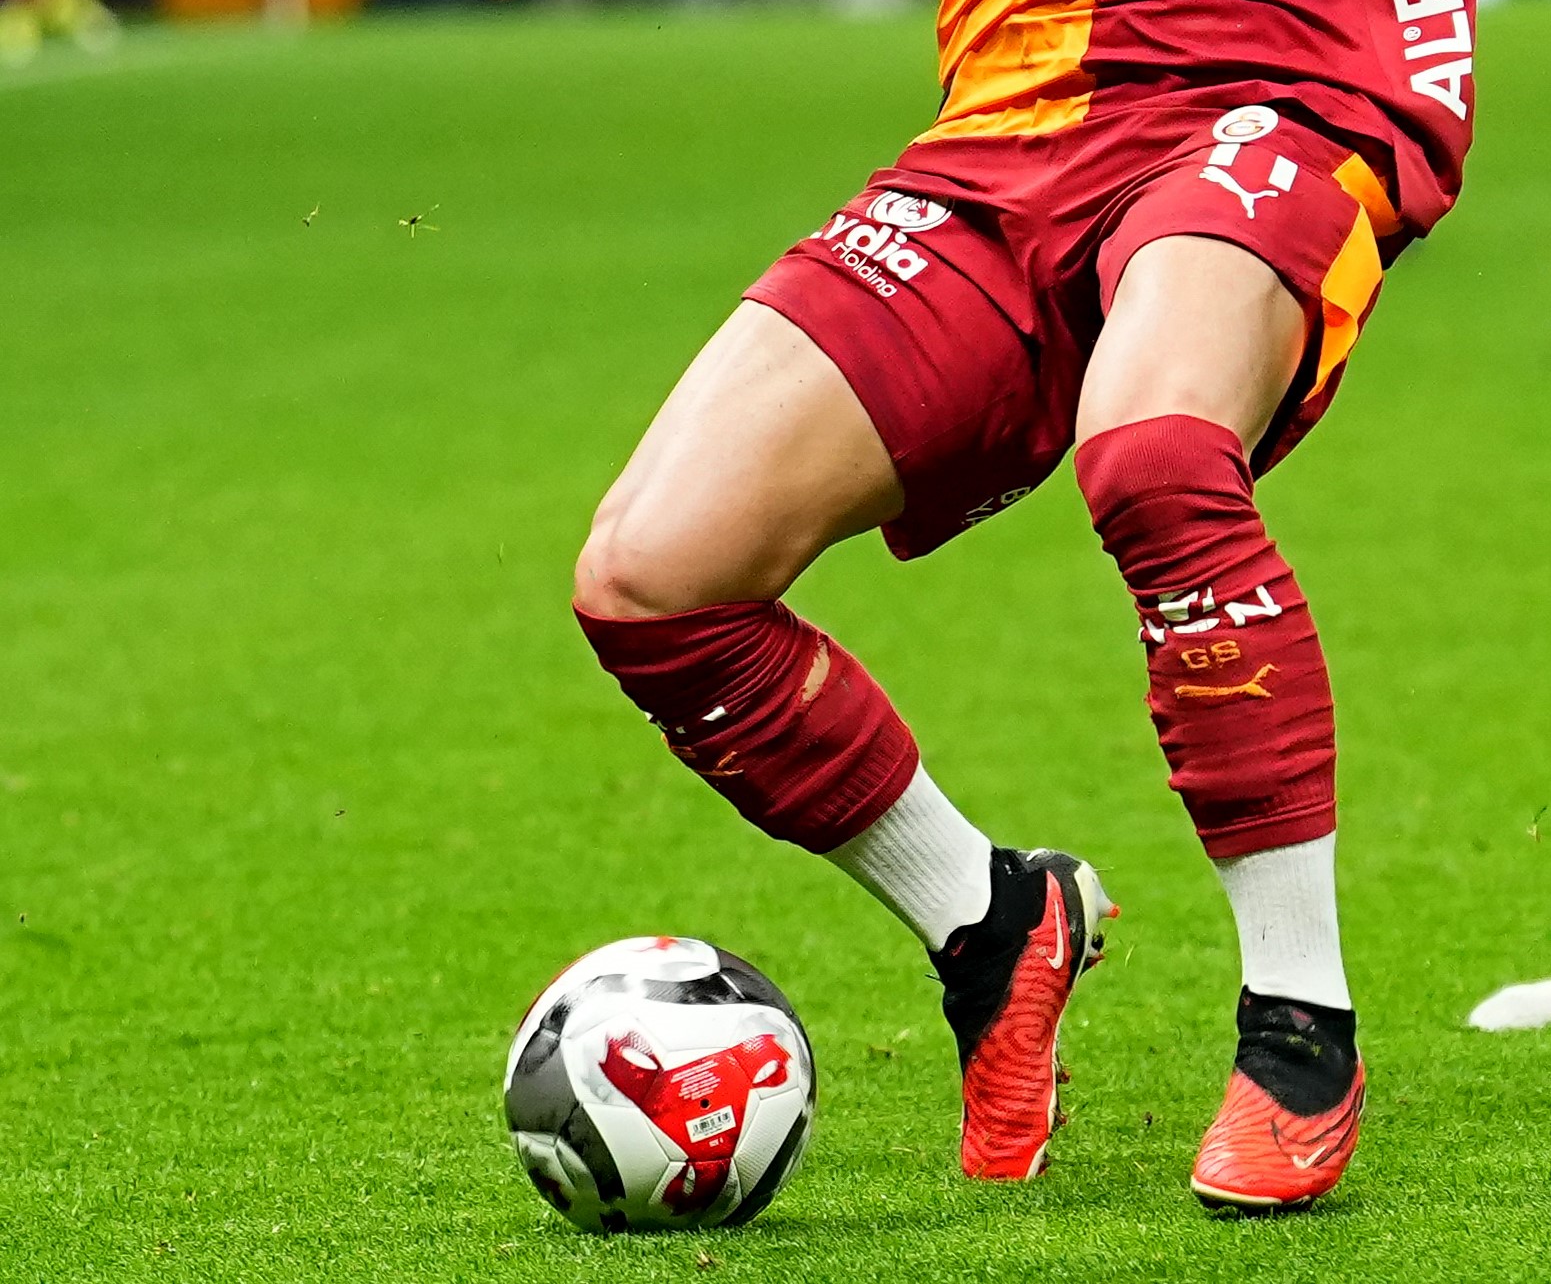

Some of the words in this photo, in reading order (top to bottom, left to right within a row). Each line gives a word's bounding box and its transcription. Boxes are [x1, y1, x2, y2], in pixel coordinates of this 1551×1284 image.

[810, 213, 929, 282] ydia
[831, 241, 898, 298] Holding
[1181, 640, 1241, 669] GS
